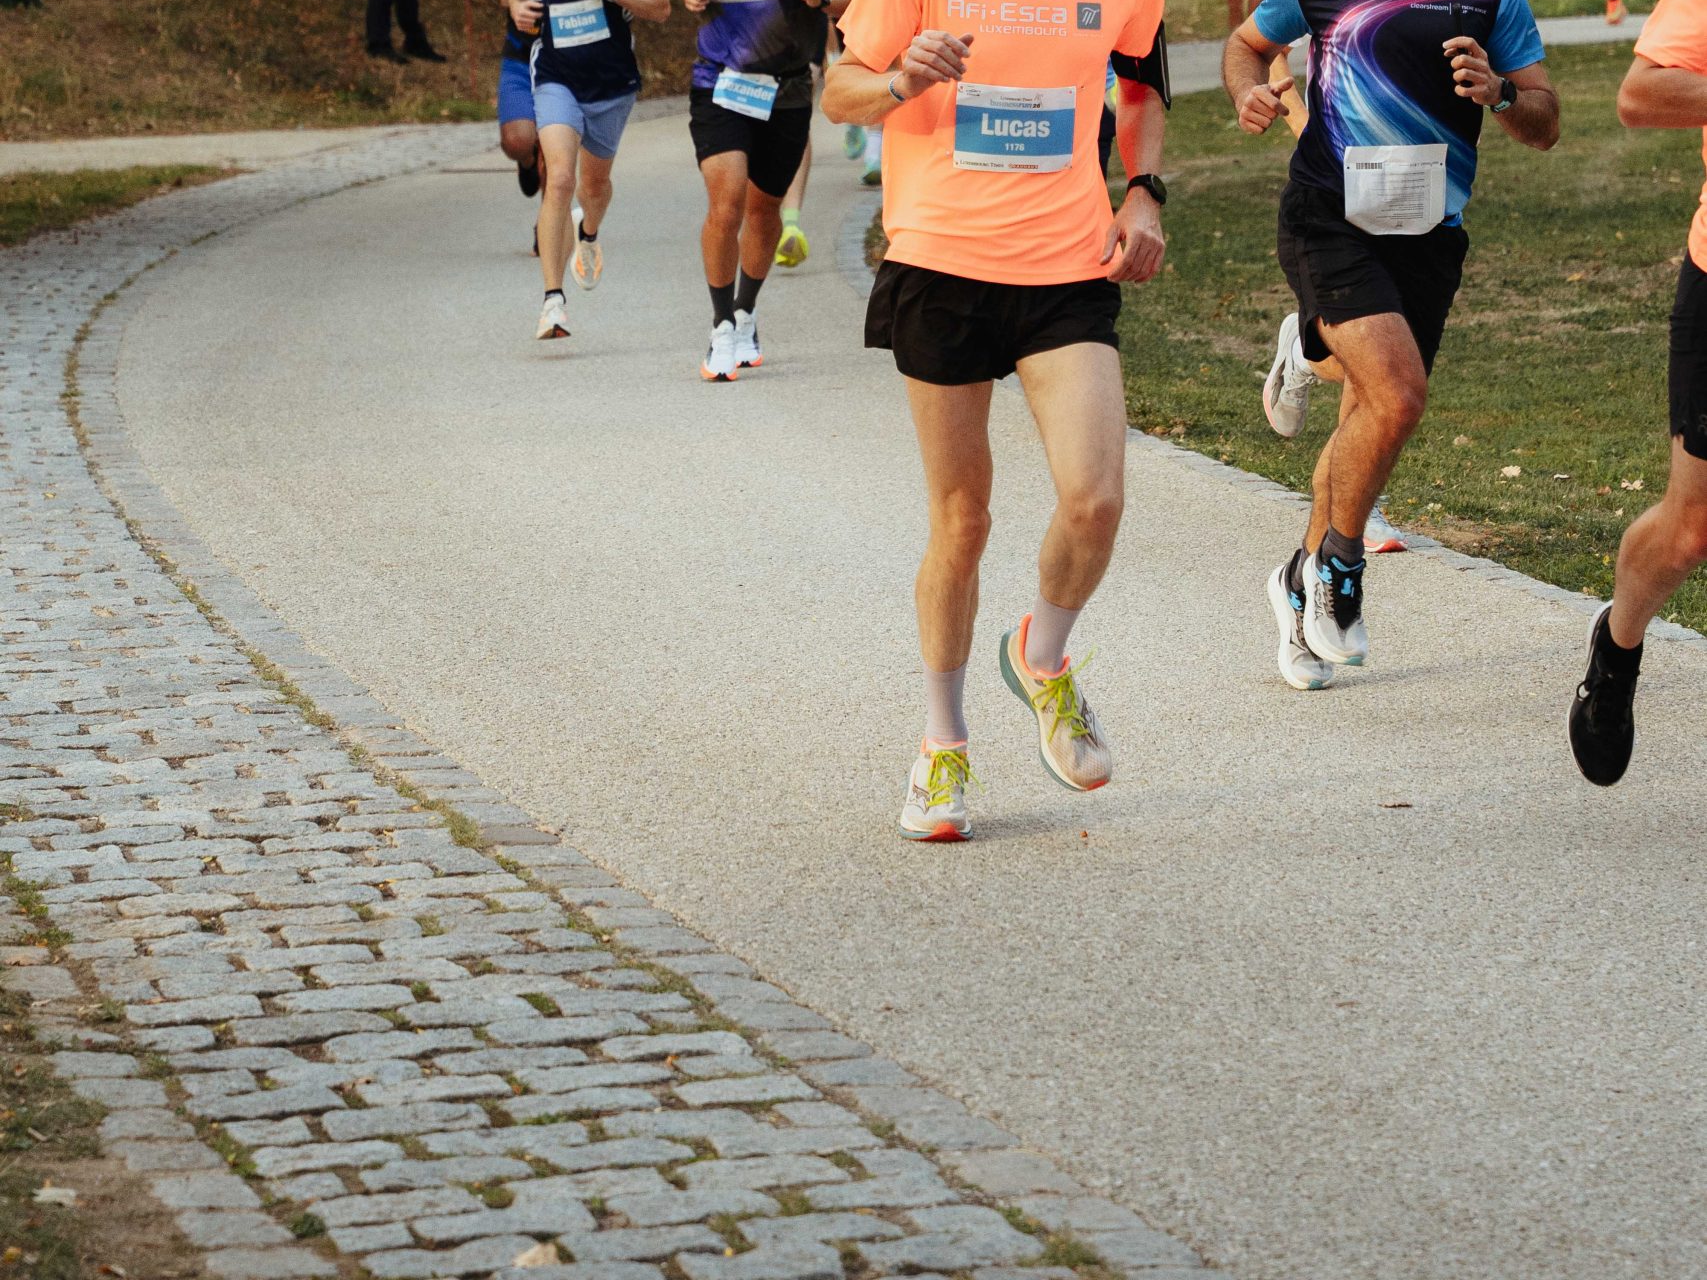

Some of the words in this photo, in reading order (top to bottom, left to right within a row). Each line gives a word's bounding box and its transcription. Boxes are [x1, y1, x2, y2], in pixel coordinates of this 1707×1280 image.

[1410, 2, 1449, 11] clearstream
[558, 13, 597, 30] Fabian
[981, 111, 1051, 138] Lucas
